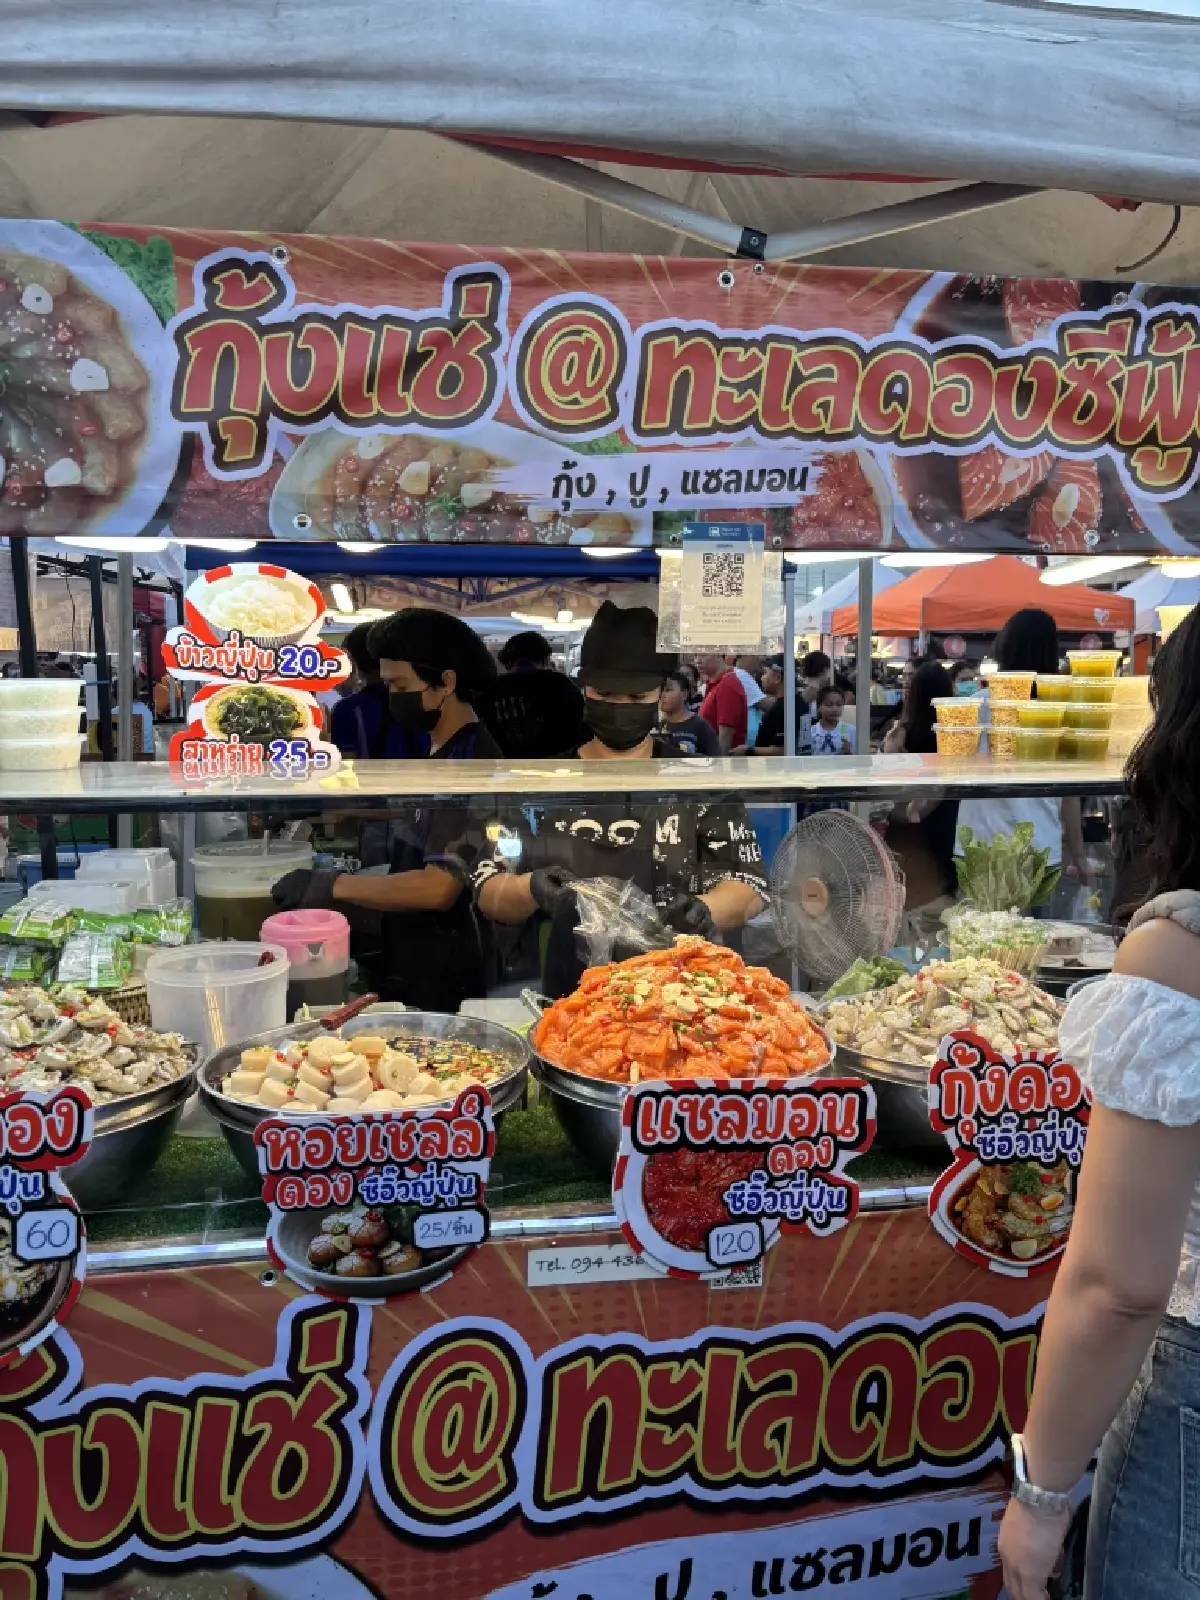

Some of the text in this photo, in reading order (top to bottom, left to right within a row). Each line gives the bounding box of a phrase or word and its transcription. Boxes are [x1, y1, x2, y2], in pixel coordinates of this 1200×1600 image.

[180, 267, 1200, 487] กุ้งแช่ @ ทะเลดองซีฟู้
[628, 463, 651, 509] ปู
[680, 465, 809, 496] แซลมอน
[176, 631, 338, 682] ข้าวญี่ปุ่น 20.-
[182, 734, 264, 762] สาหร่าย
[941, 1042, 1094, 1145] กุ้งดอ
[0, 1099, 79, 1157] อง
[264, 1094, 483, 1170] หอยเชลล์
[769, 1137, 835, 1176] ดอง
[277, 1172, 353, 1210] ดอง
[26, 1219, 71, 1250] 60
[715, 1229, 755, 1257] 120
[391, 1338, 517, 1516] @
[750, 1515, 983, 1599] แซลมอน
